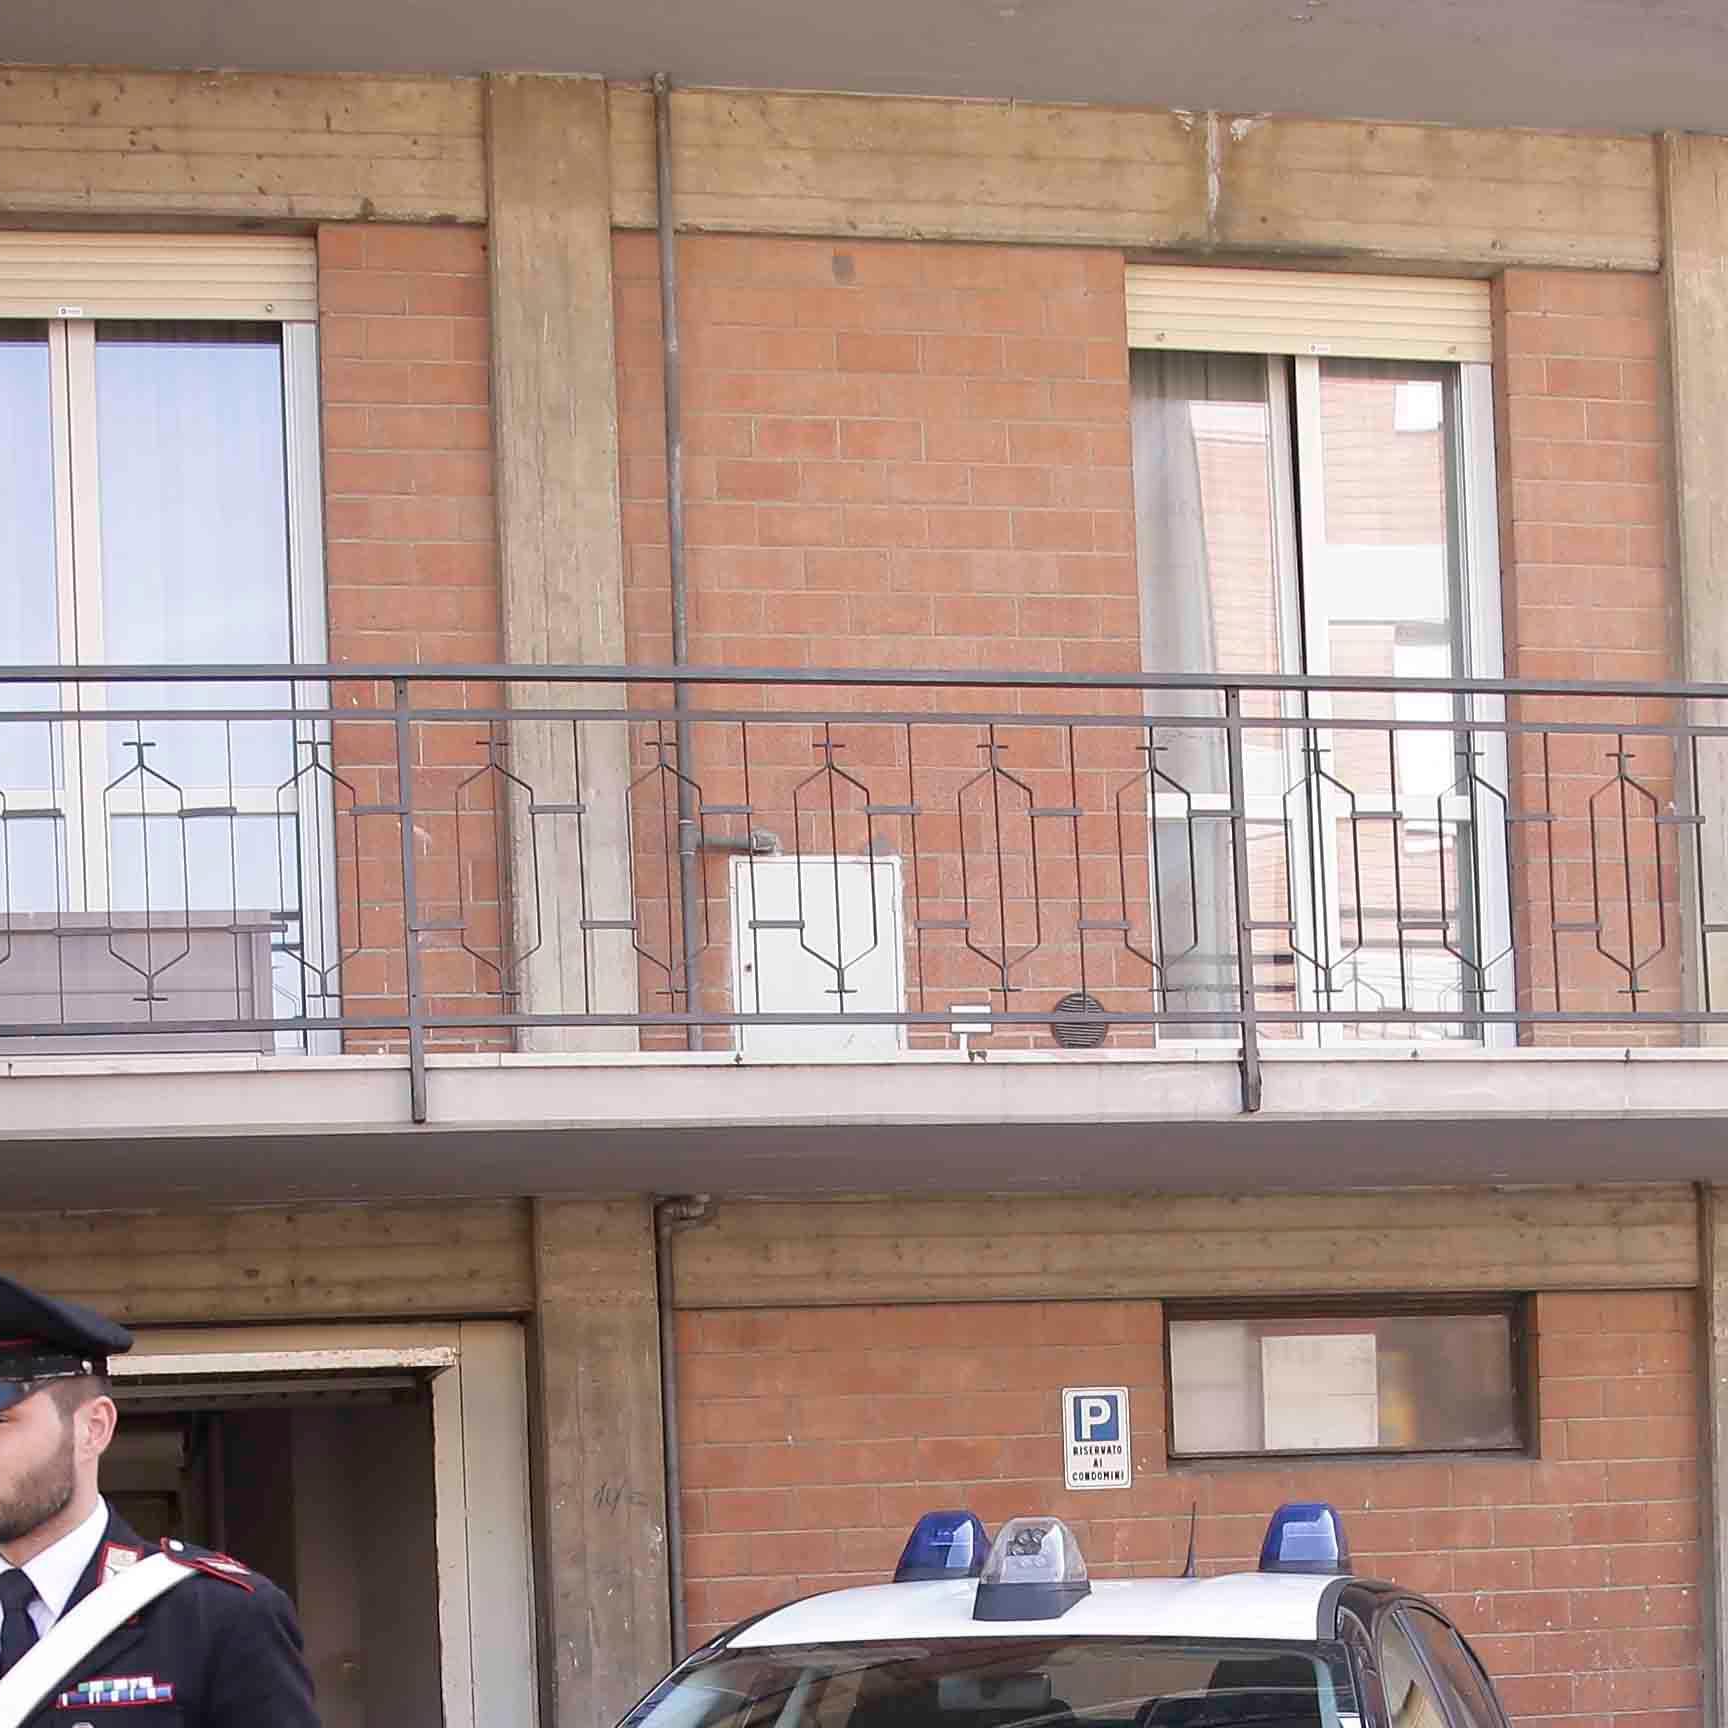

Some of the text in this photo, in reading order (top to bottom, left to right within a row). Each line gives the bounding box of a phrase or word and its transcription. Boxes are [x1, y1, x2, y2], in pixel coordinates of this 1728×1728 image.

[1080, 1398, 1111, 1440] P
[1073, 1445, 1122, 1456] RISERVATO
[1093, 1458, 1103, 1468] AI
[1072, 1471, 1124, 1481] CONDOMINI
